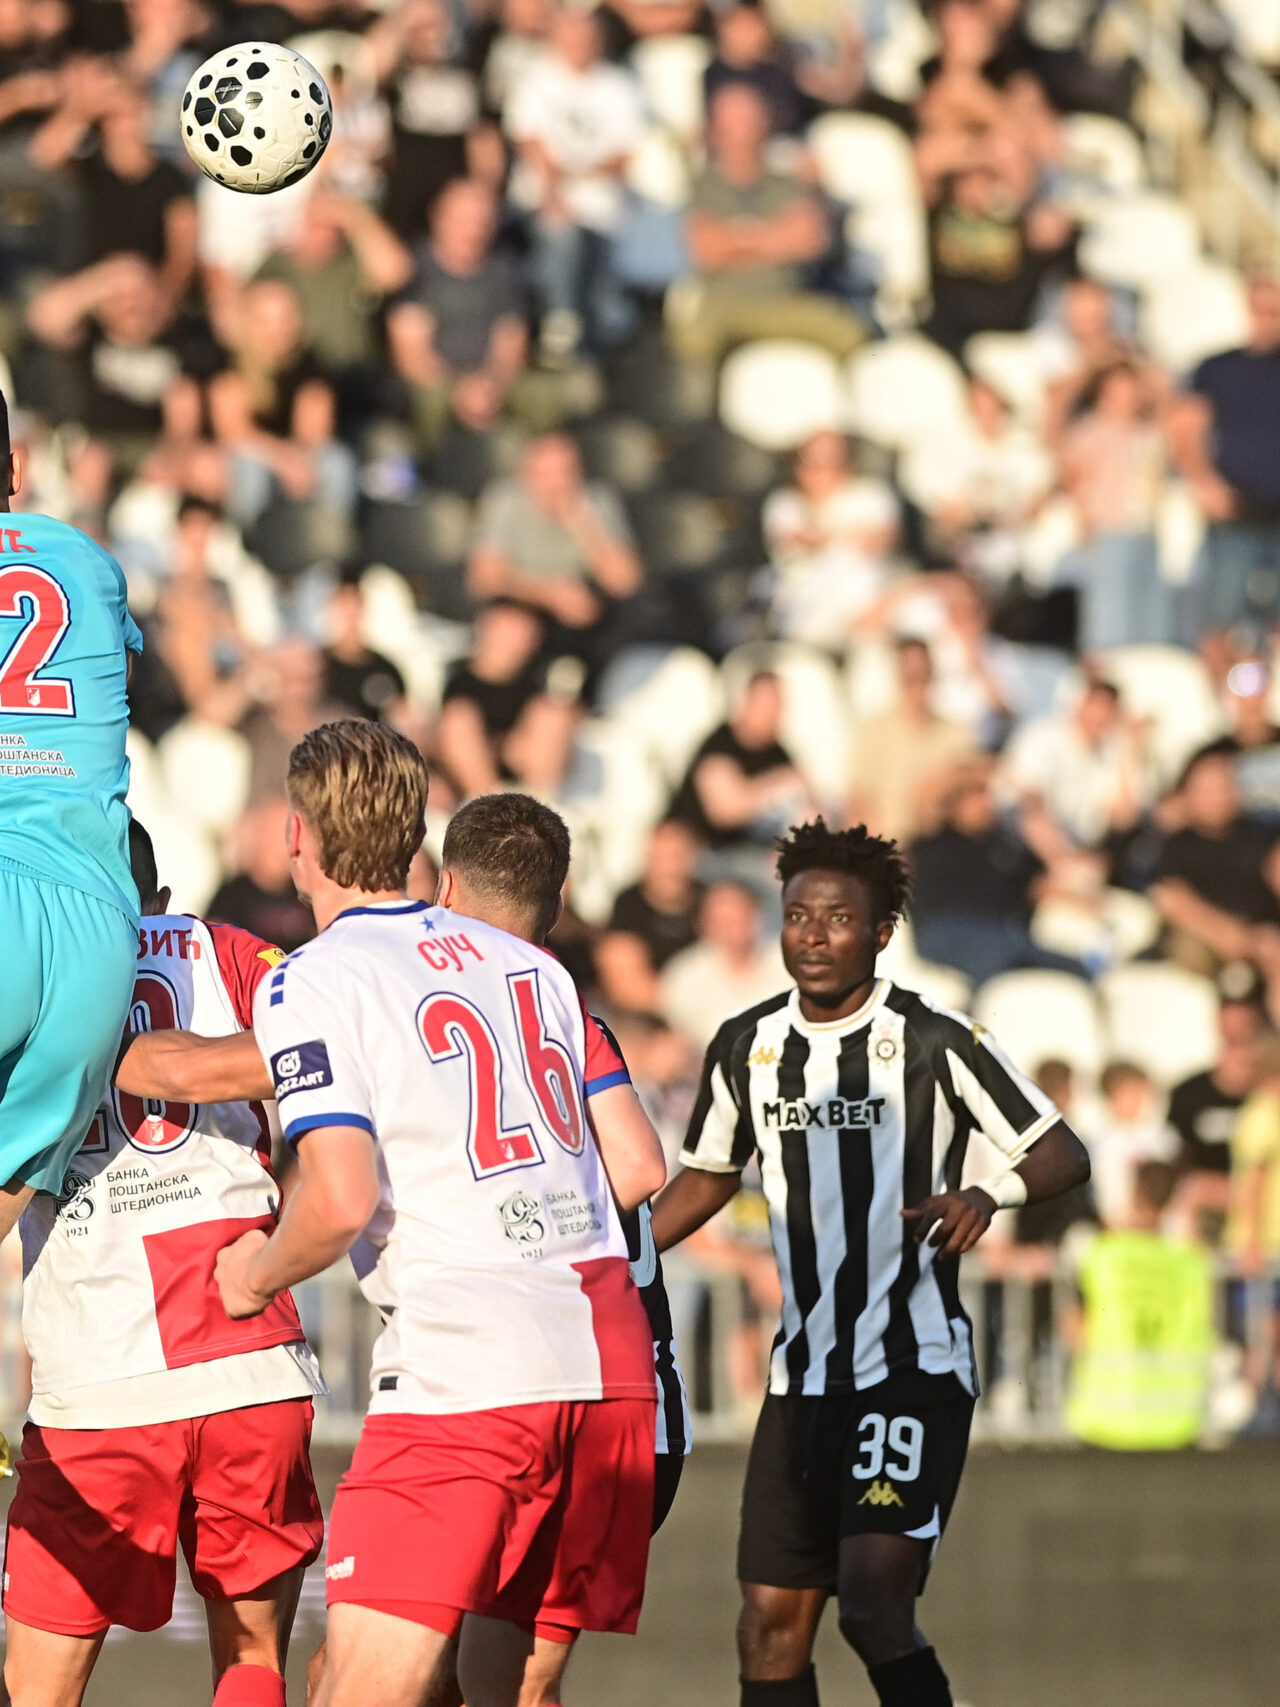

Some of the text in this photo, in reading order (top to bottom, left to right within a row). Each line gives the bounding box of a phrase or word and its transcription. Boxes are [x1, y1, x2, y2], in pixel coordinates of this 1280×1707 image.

[417, 933, 485, 972] СУЧ
[275, 1070, 325, 1099] OZZART
[415, 968, 586, 1181] 26
[763, 1097, 886, 1129] MAXBET
[106, 1167, 150, 1183] БАНКА
[109, 1173, 190, 1199] ПОШТАНСКА
[110, 1186, 202, 1214] ШТЕДИОНИЦА
[545, 1190, 577, 1205] БАНКА
[66, 1226, 89, 1238] 1921
[852, 1412, 924, 1482] 39
